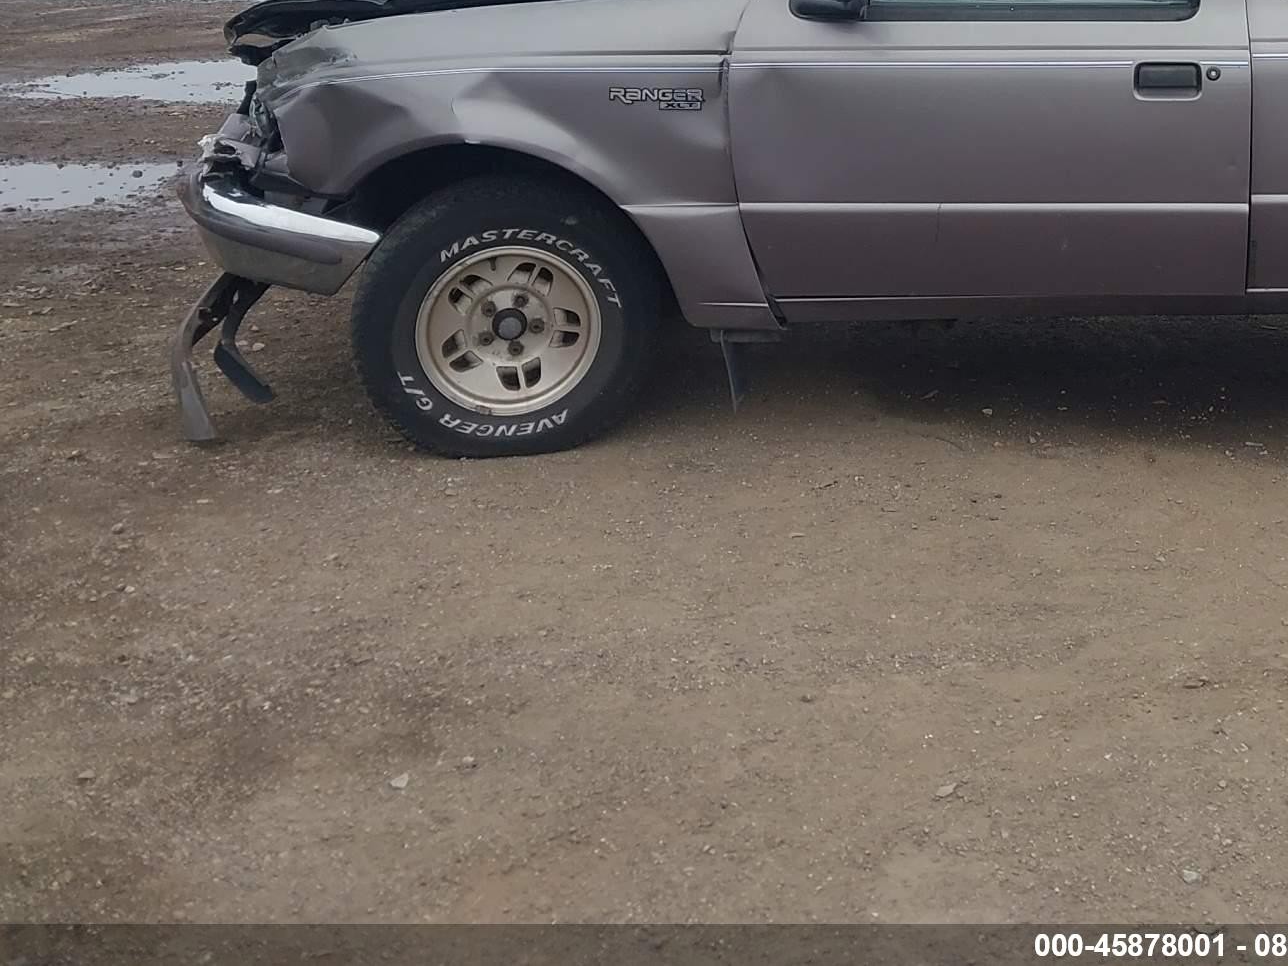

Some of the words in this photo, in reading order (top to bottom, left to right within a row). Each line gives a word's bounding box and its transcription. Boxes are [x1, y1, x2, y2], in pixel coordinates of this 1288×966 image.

[608, 87, 704, 104] RANGER
[439, 228, 622, 309] MASTERCRAFT
[438, 408, 569, 437] AVENGER
